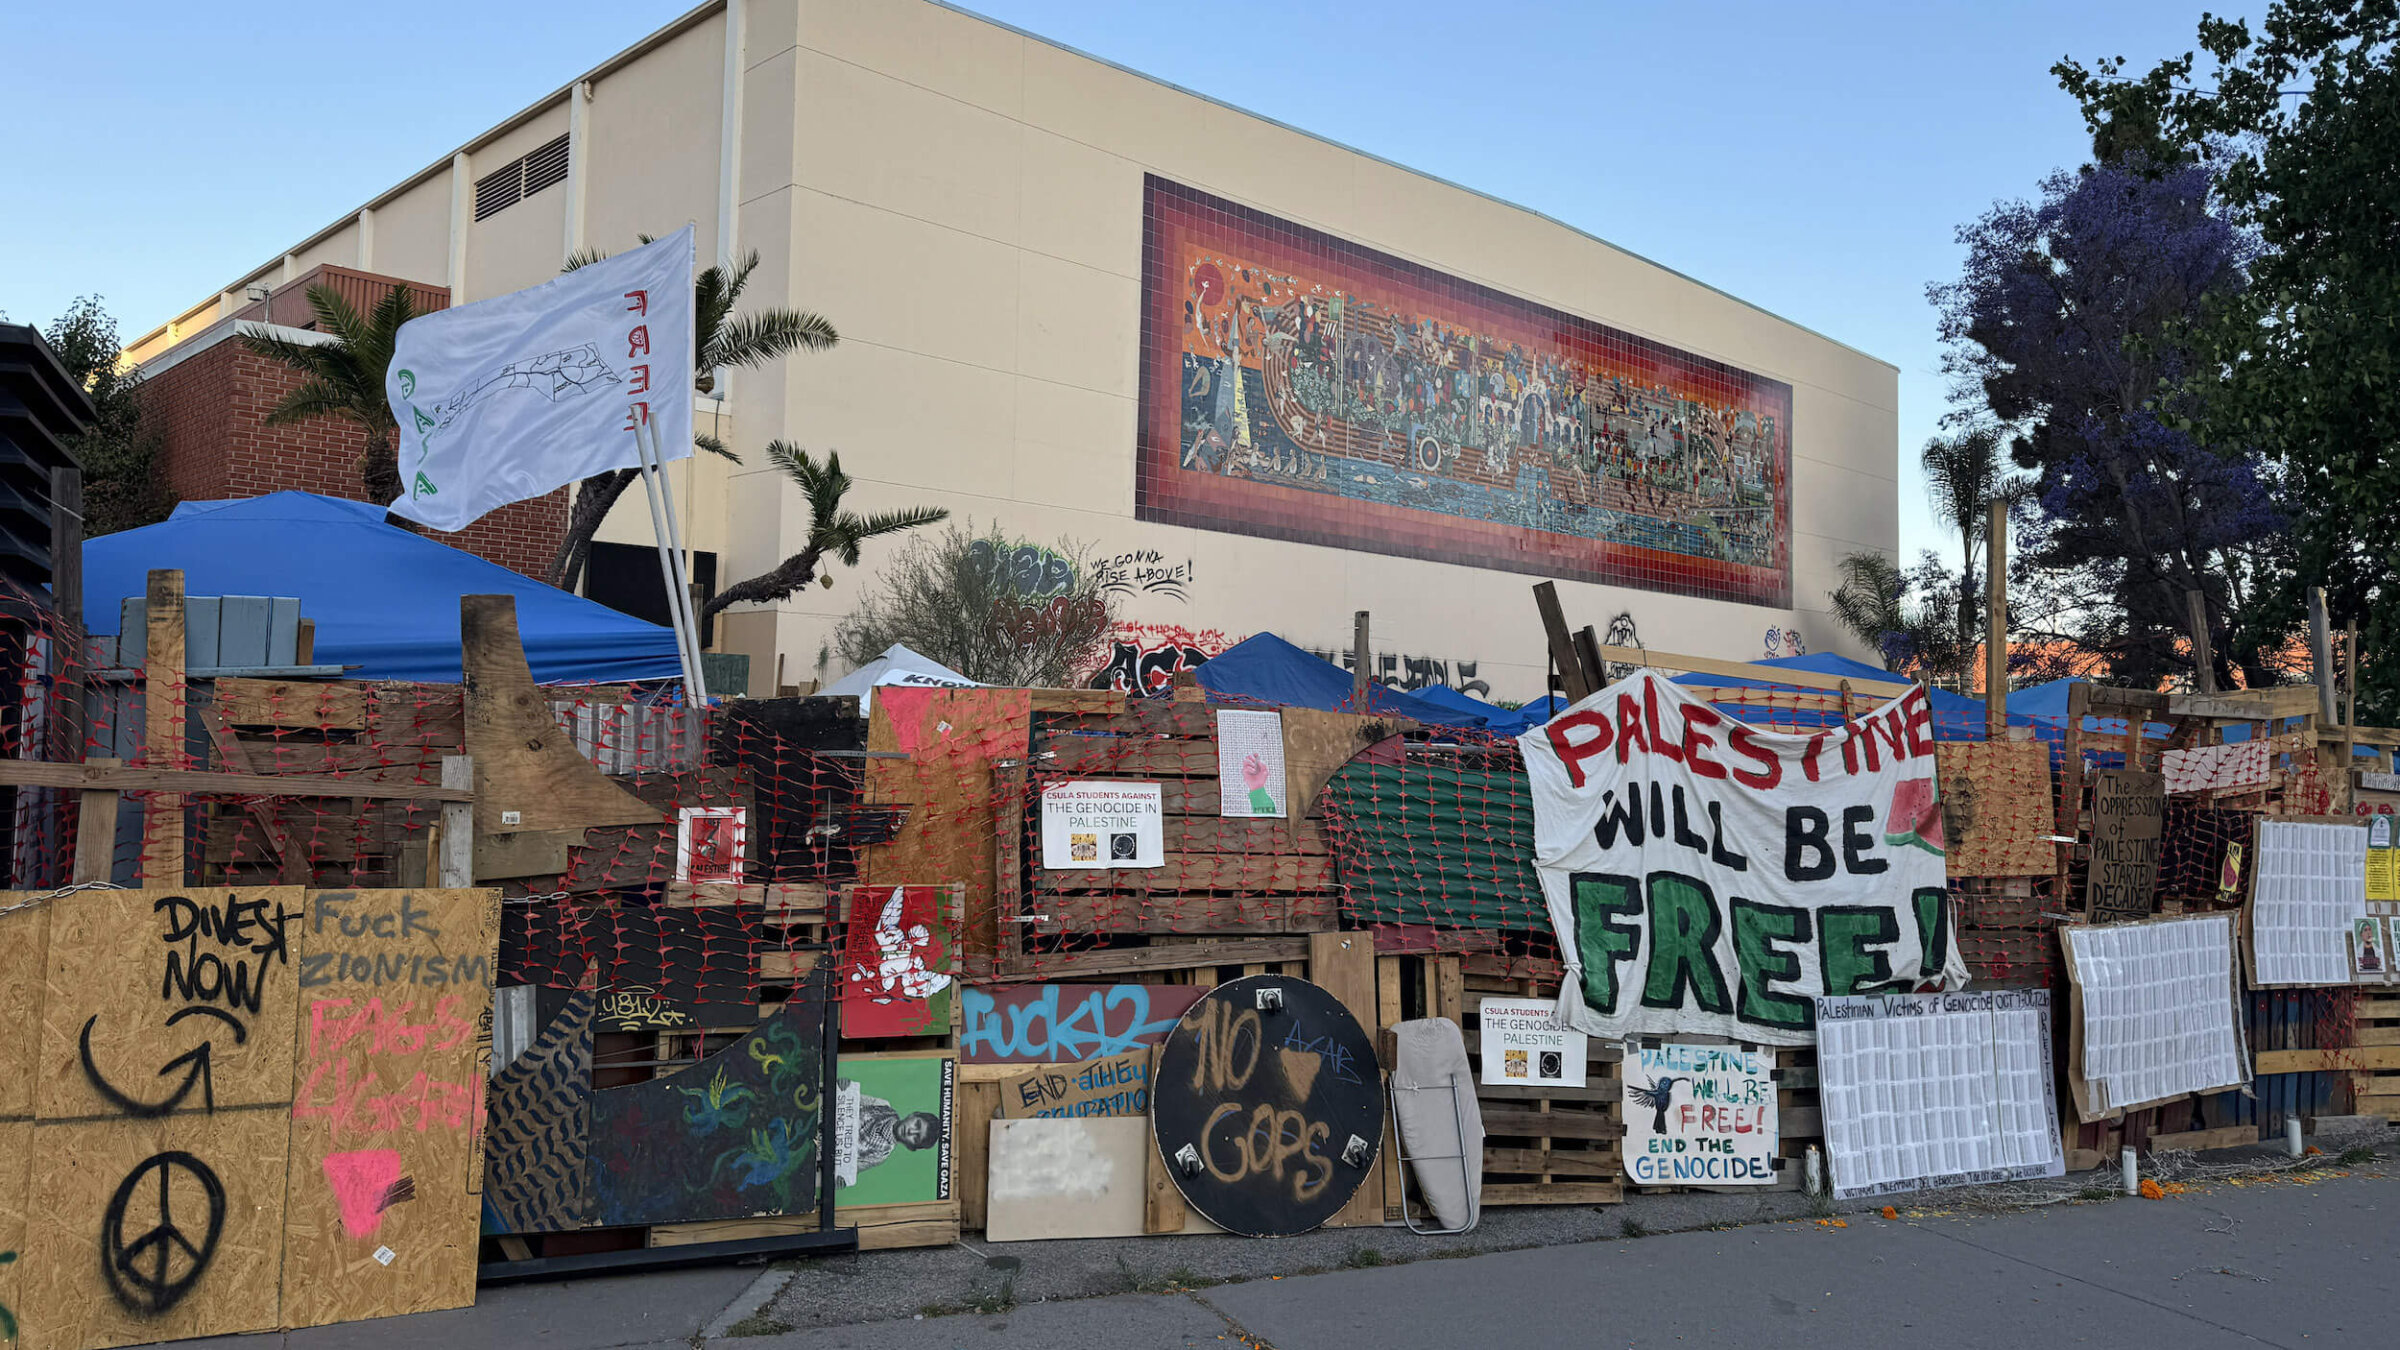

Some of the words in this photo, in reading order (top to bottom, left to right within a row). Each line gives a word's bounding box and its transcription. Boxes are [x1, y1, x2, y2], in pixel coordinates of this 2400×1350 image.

[1090, 557, 1111, 570] WE
[1114, 549, 1164, 568] GONNA
[1095, 569, 1130, 583] RISE
[1547, 674, 1935, 790] PALESTINE
[1046, 792, 1074, 800] CSULA
[1076, 792, 1120, 800] STUDENTS
[1121, 792, 1157, 800] AGAINST
[2104, 775, 2130, 795] The
[1047, 802, 1073, 813] THE
[1075, 802, 1143, 814] GENOCIDE
[1145, 803, 1157, 814] IN
[2100, 796, 2165, 817] OPPRESSION
[1069, 816, 1137, 828] PALESTINE
[1594, 781, 1748, 872] WILL
[1784, 805, 1890, 882] BE
[2109, 817, 2126, 838] of
[2095, 837, 2159, 863] PALESTINE
[2104, 863, 2152, 886] STARTED
[2093, 882, 2153, 910] DECADES
[1569, 871, 1949, 1031] FREE!
[162, 933, 272, 1014] NOW
[300, 951, 491, 989] ZIONISM
[1510, 1008, 1549, 1017] STUDENTS
[1943, 994, 1992, 1013] GENOCIDE
[1995, 994, 2014, 1010] OCT
[1485, 1018, 1507, 1029] THE
[1182, 997, 1262, 1092] NO
[1503, 1033, 1564, 1046] PALESTINE
[1640, 1047, 1758, 1075] PALESTINE
[944, 1061, 952, 1085] SAVE
[1019, 1074, 1068, 1107] END
[1692, 1077, 1739, 1104] WILL
[1743, 1079, 1772, 1105] BE
[836, 1094, 846, 1135] SILENCE
[845, 1097, 854, 1120] THEY
[941, 1087, 952, 1143] HUMANITY.
[1680, 1104, 1765, 1135] FREE!
[835, 1135, 844, 1147] US
[843, 1124, 853, 1148] TRIED
[1648, 1138, 1687, 1154] END
[1695, 1137, 1735, 1154] THE
[842, 1150, 852, 1164] TO
[941, 1143, 950, 1165] SAVE
[1636, 1151, 1774, 1180] GENOCIDE!
[940, 1165, 949, 1198] GAZA
